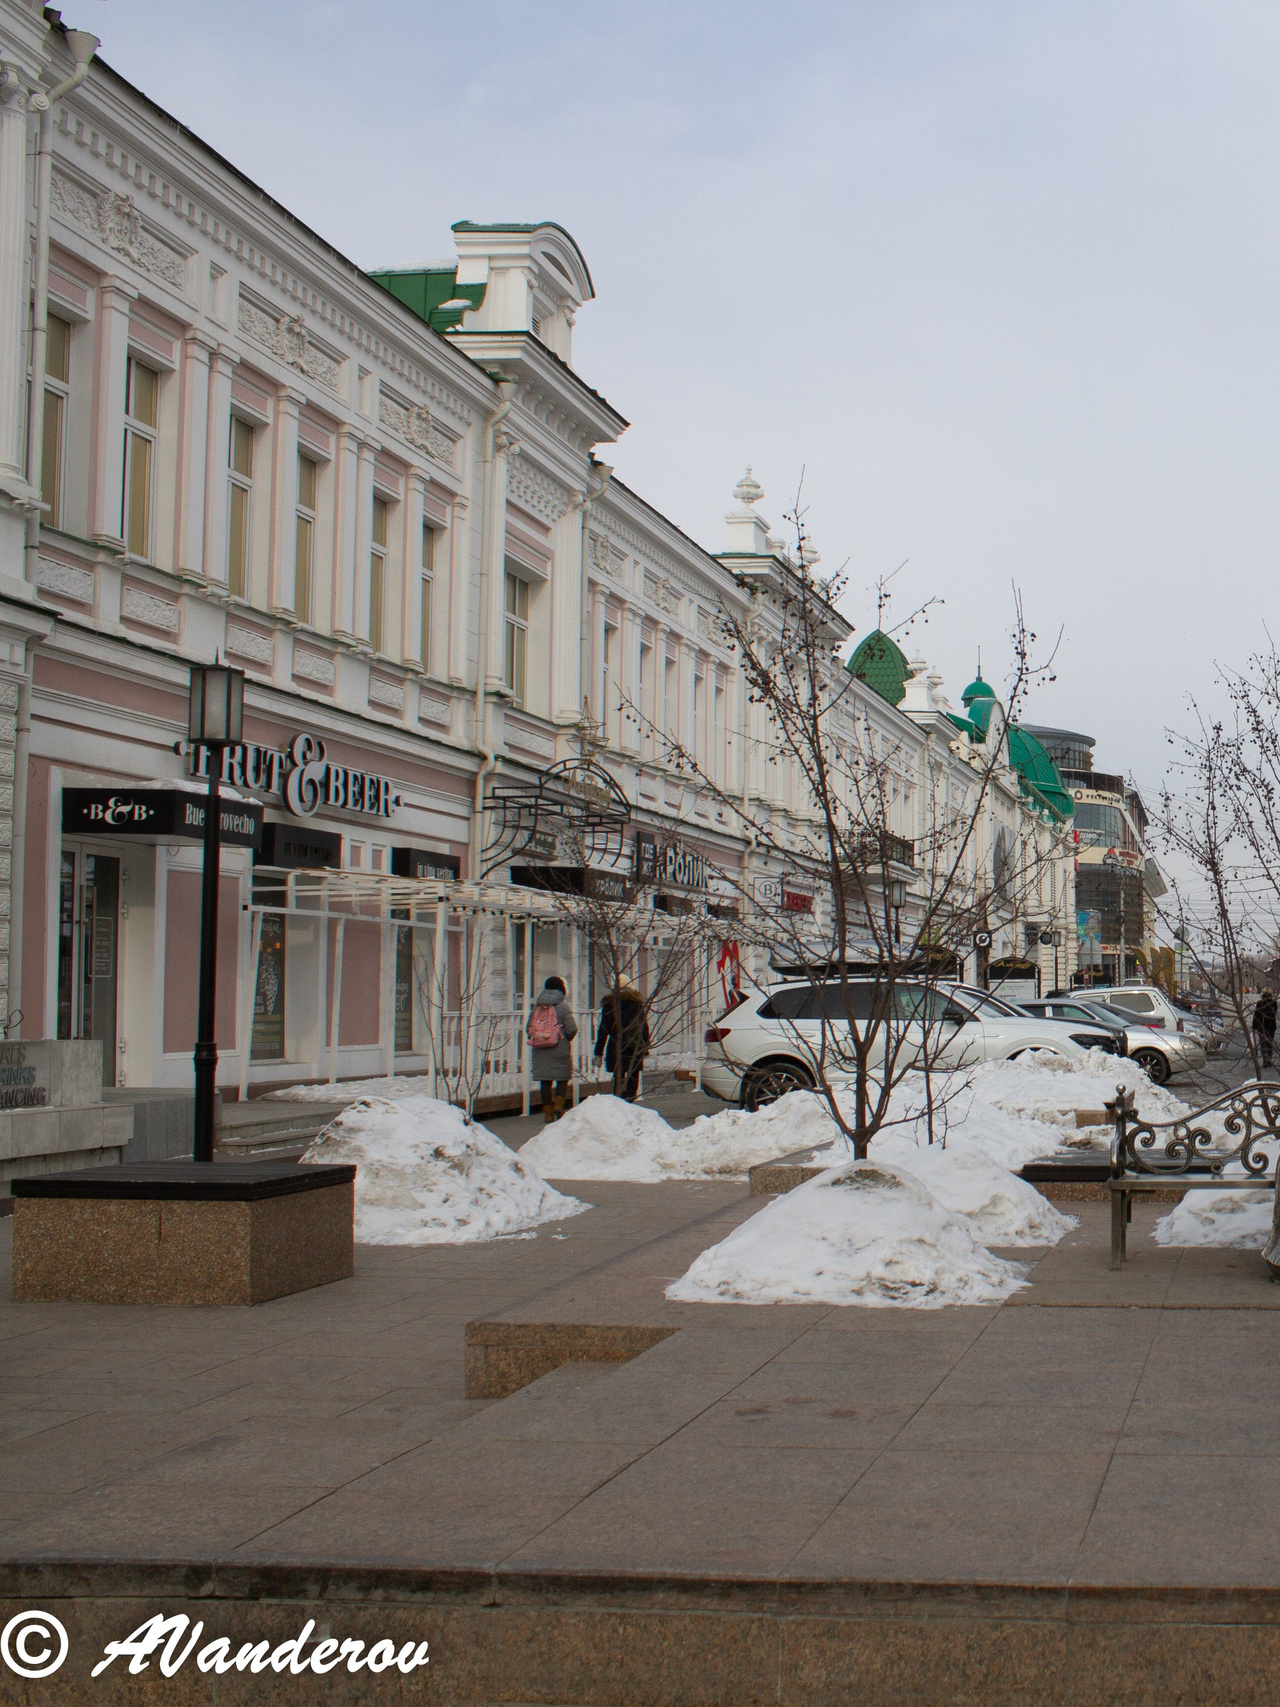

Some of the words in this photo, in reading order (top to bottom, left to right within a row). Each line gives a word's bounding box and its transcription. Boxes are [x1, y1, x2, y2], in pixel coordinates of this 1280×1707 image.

[326, 764, 395, 818] BEER
[184, 803, 206, 827] Bue
[219, 812, 255, 835] rovecho
